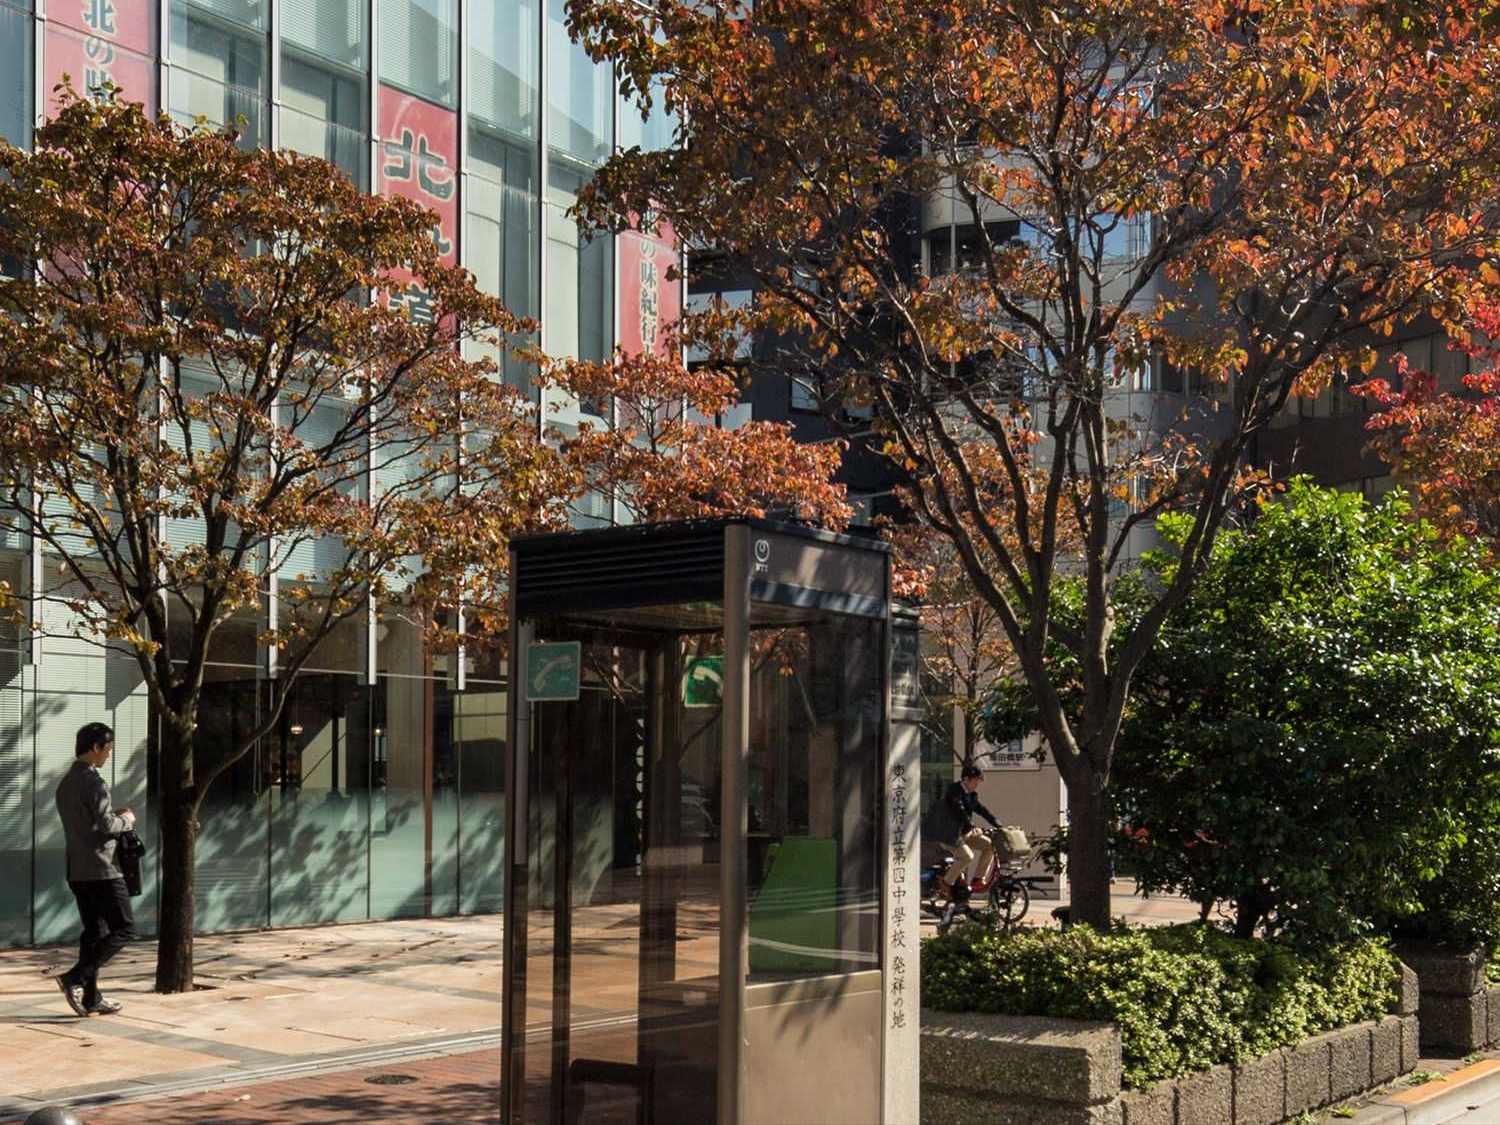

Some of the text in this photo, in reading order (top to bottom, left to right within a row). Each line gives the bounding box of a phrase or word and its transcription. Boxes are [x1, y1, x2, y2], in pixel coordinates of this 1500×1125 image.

[755, 563, 769, 573] NTT
[891, 763, 907, 1029] 東京府立第四中學校 発祥の地
